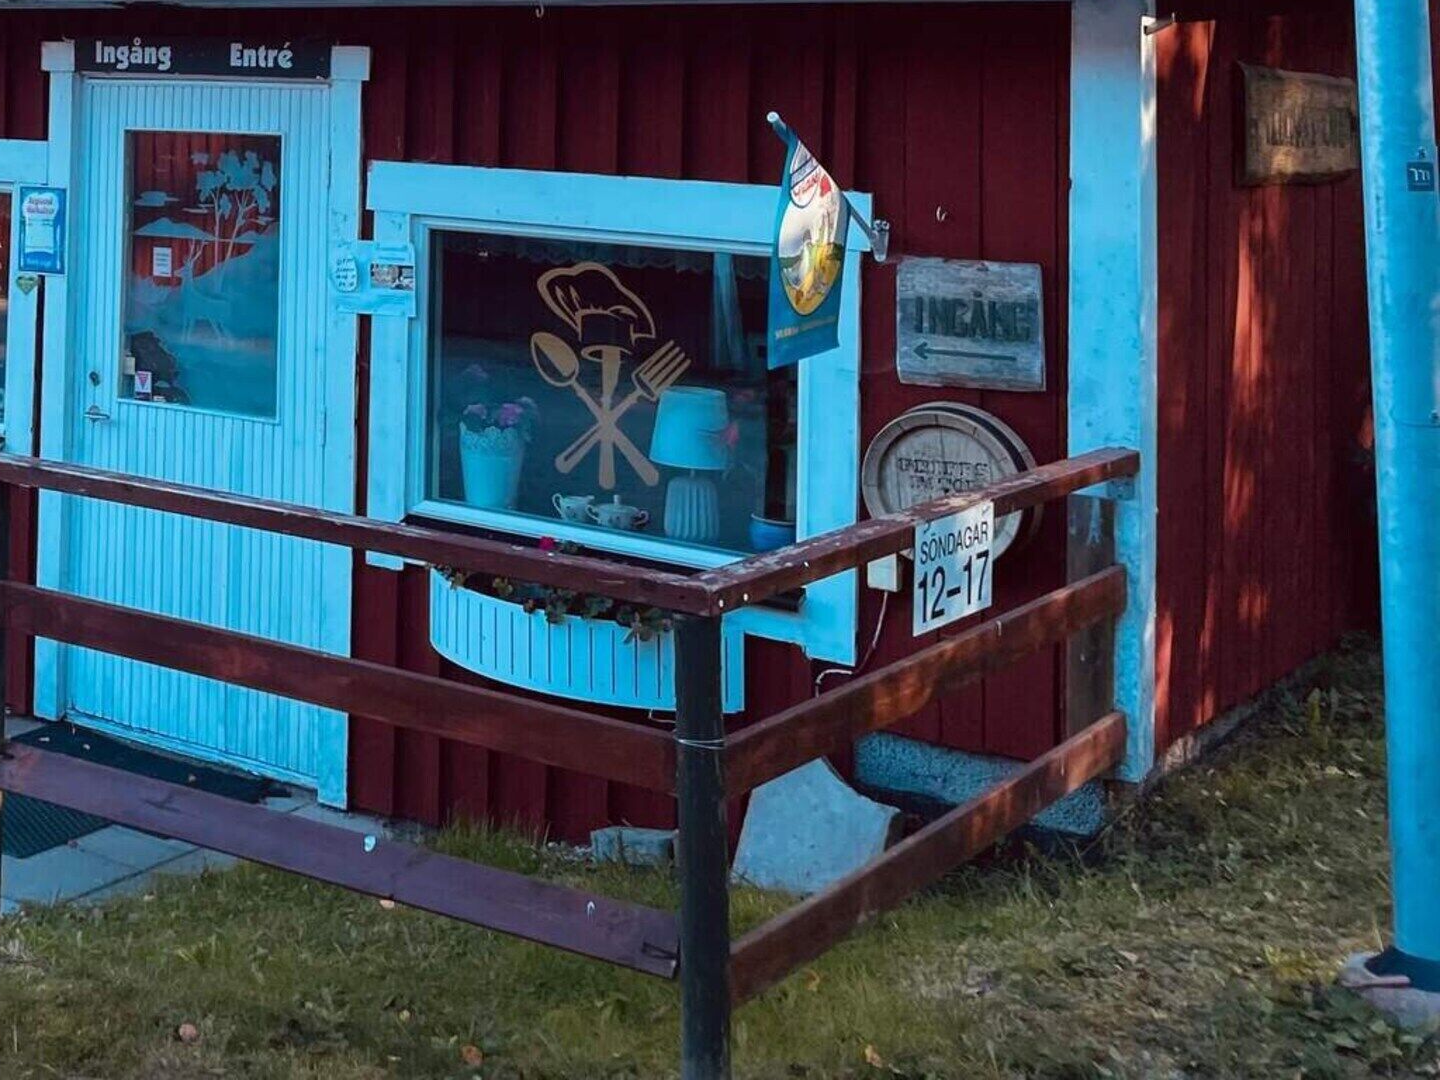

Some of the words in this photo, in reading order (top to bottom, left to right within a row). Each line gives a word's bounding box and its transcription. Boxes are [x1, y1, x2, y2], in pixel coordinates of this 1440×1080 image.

[95, 36, 172, 70] Ingång
[229, 41, 294, 69] Entré
[913, 289, 1033, 343] INGÅNG
[920, 521, 989, 565] SÖNDAGAR
[917, 550, 990, 624] 12-17
